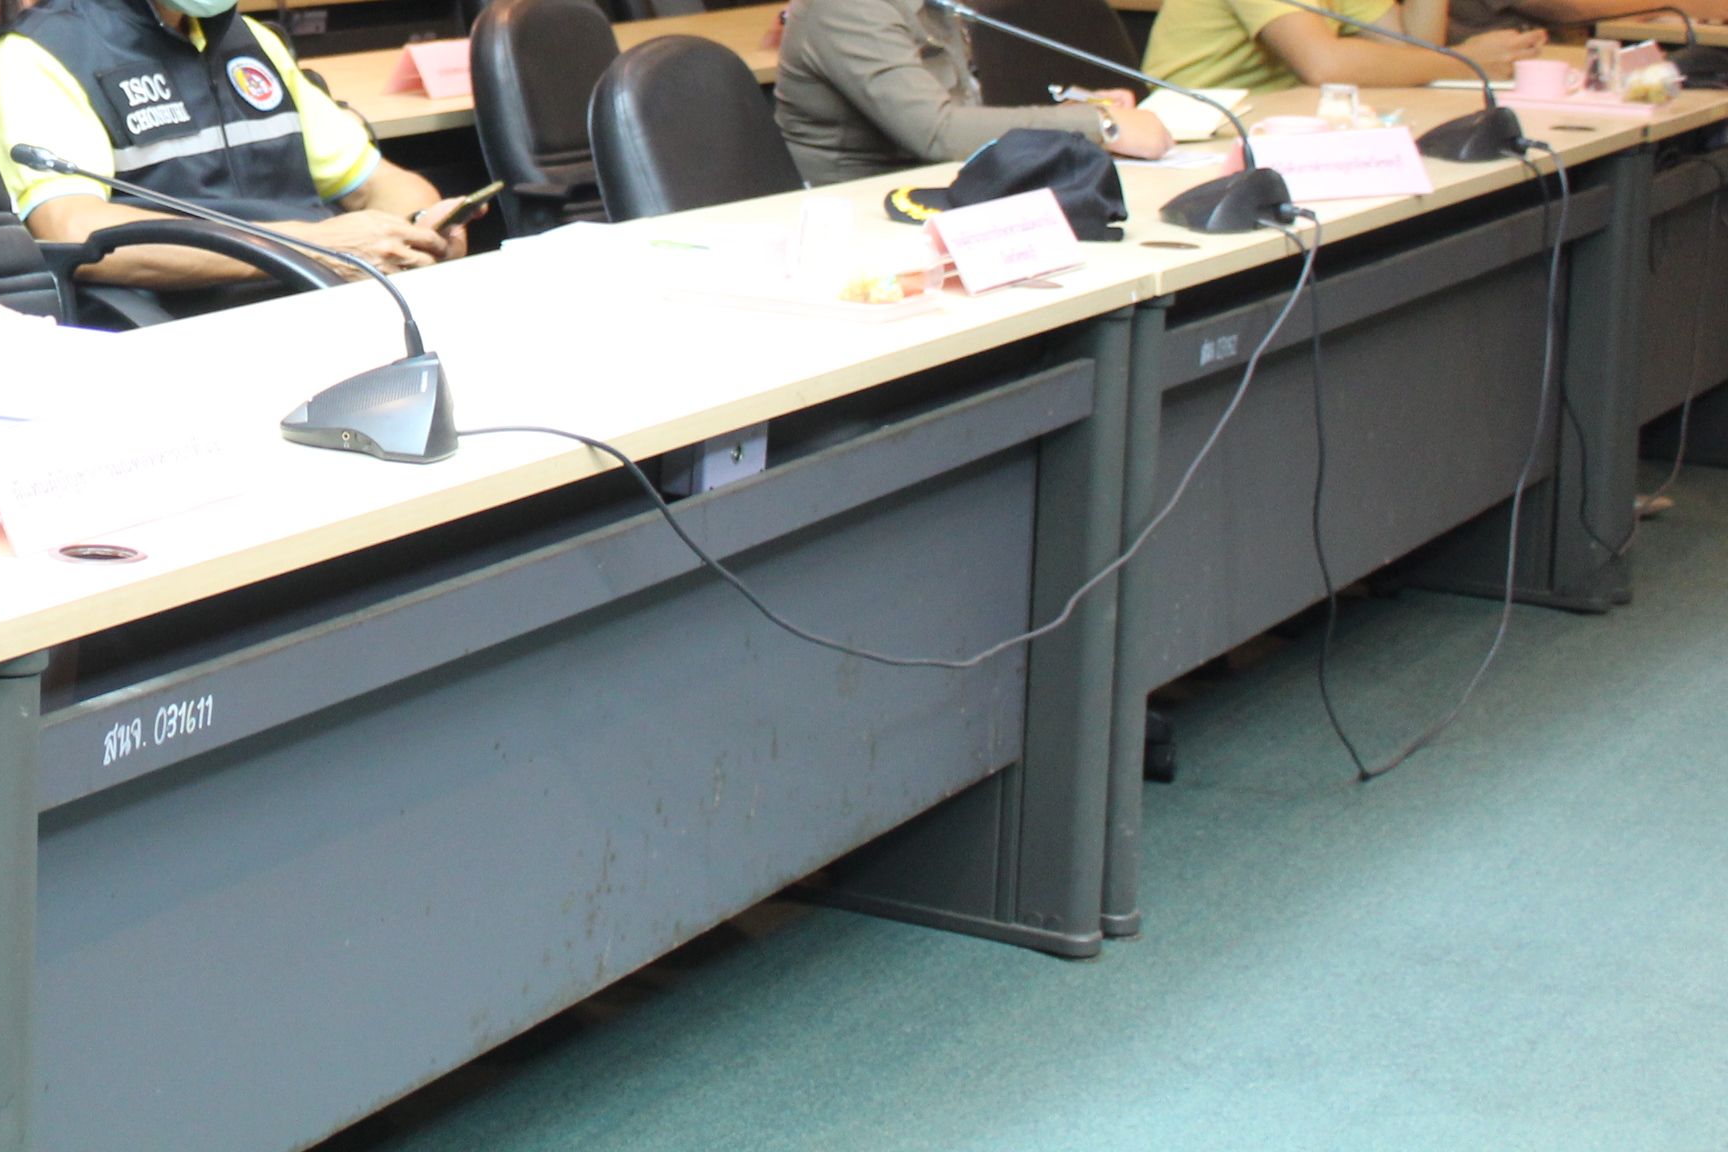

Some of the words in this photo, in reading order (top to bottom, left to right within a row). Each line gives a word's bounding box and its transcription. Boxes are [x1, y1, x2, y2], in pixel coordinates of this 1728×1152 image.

[119, 73, 172, 106] ISOC
[126, 101, 191, 135] CHONBURI
[153, 694, 214, 746] 031611
